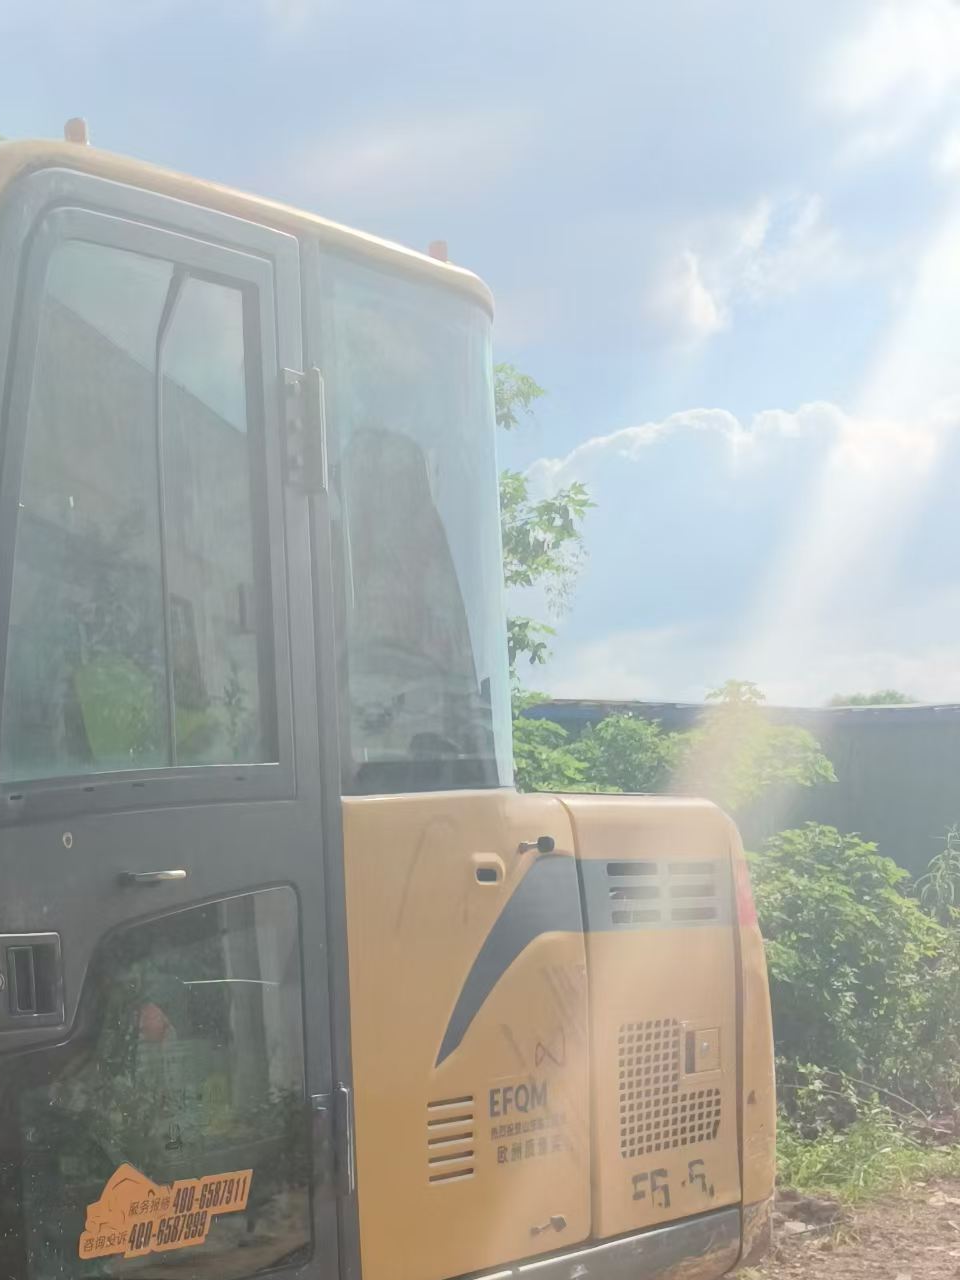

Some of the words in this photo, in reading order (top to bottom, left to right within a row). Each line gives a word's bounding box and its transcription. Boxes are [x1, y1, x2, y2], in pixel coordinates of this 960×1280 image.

[489, 1080, 548, 1117] EFQM
[172, 1177, 248, 1214] 400-6587911
[128, 1210, 208, 1251] 400-6587999
